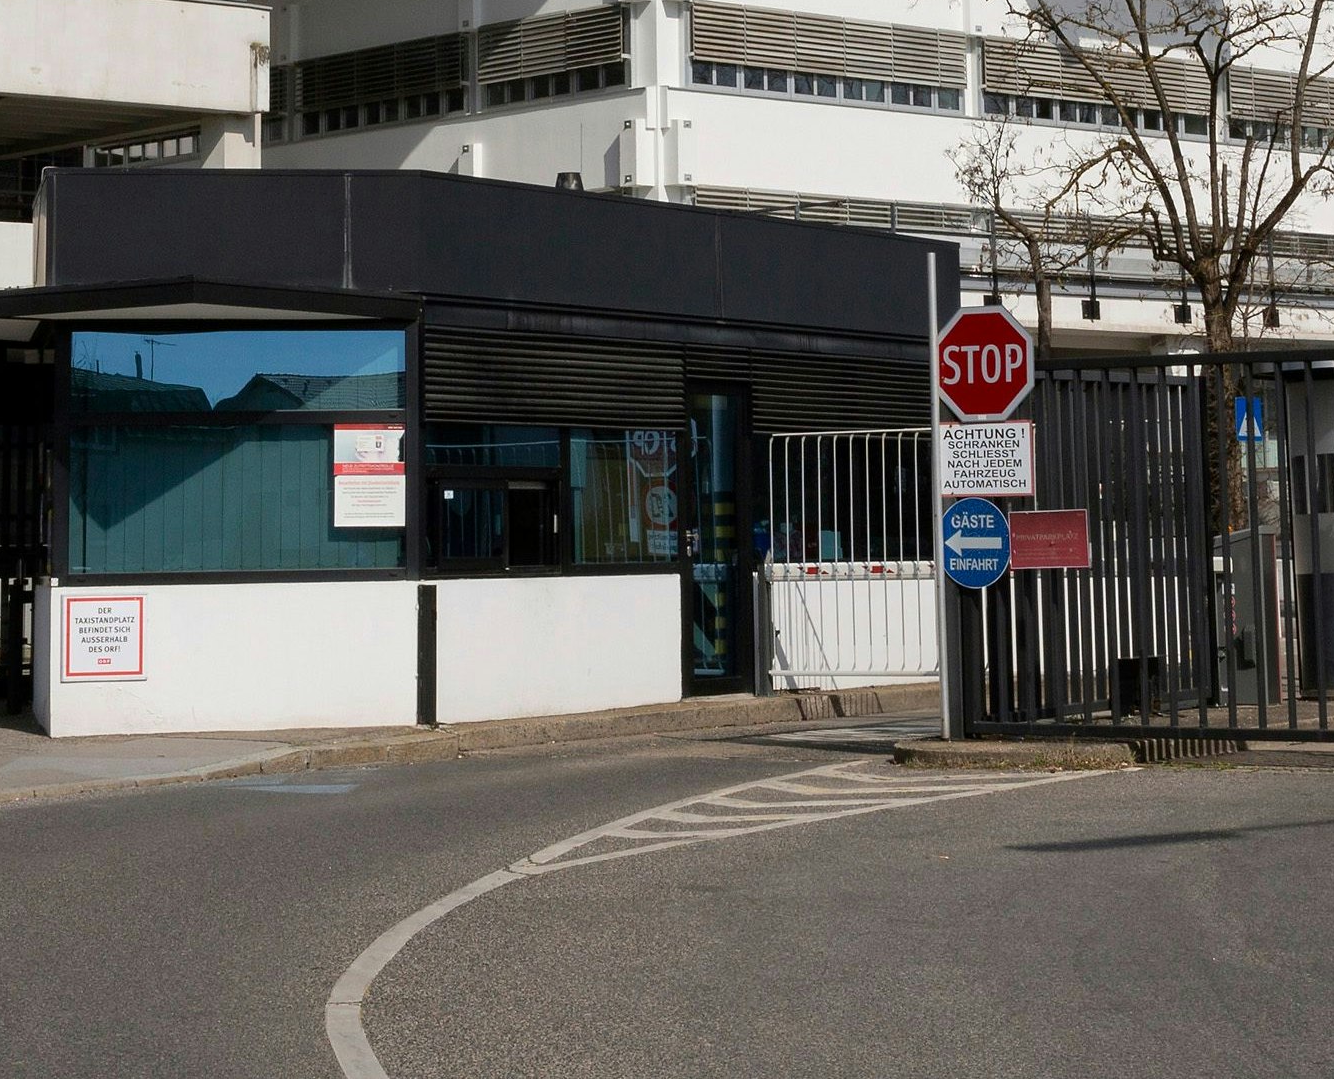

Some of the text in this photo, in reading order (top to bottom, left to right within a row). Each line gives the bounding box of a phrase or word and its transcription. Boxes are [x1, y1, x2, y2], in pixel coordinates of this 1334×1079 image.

[942, 344, 1023, 385] STOP
[943, 428, 1016, 440] ACHTUNG
[948, 440, 1020, 449] SCHRANKEN
[952, 449, 1016, 459] SCHLIESST
[947, 459, 1022, 468] NACH JEDEM
[953, 469, 1016, 478] FAHRZEUG
[943, 479, 1027, 489] AUTOMATISCH
[951, 511, 994, 528] GÄSTE
[950, 558, 998, 571] EINFAHRT
[75, 616, 135, 624] TAXISTANDPLATZ
